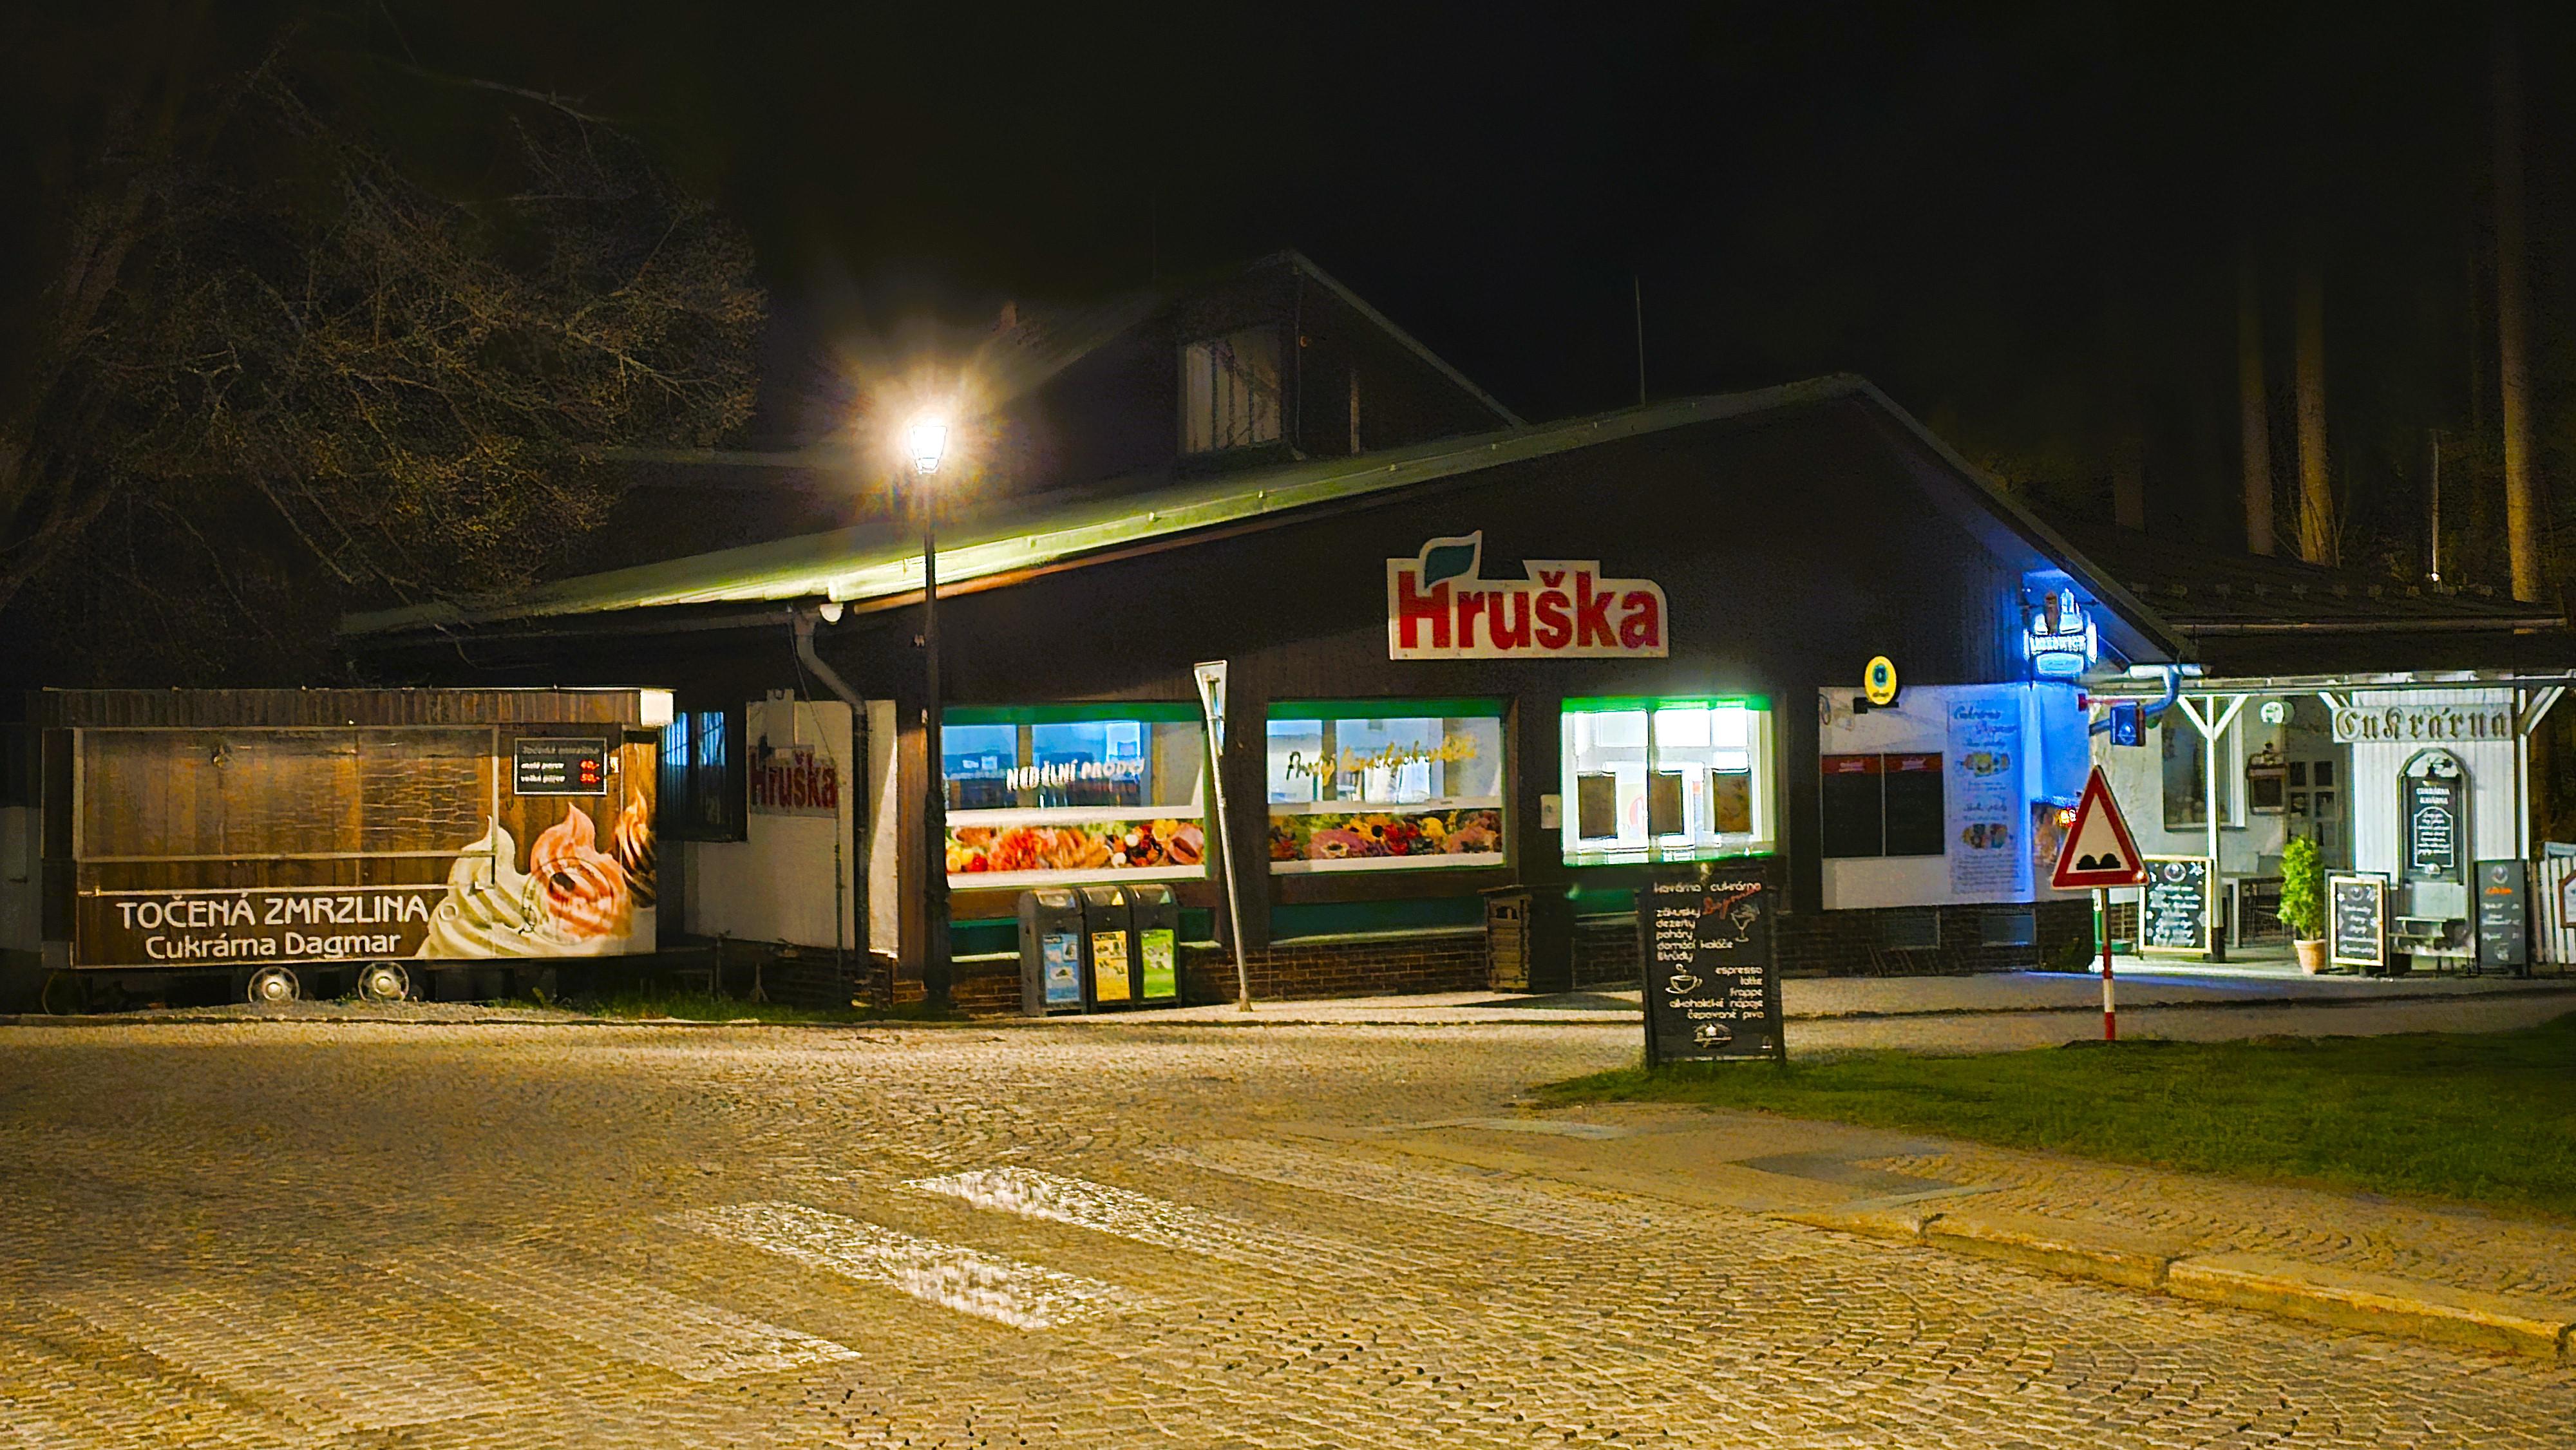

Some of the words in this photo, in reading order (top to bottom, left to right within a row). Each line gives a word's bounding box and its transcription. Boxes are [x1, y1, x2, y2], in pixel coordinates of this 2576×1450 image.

[1397, 570, 1660, 650] Hruška
[750, 749, 836, 809] Hruška
[115, 892, 256, 929] TOČENÁ
[264, 895, 429, 925] ZMRZLINA
[146, 933, 276, 959] Cukrárna
[285, 932, 401, 959] Dagmar
[1715, 967, 1763, 976] espresso
